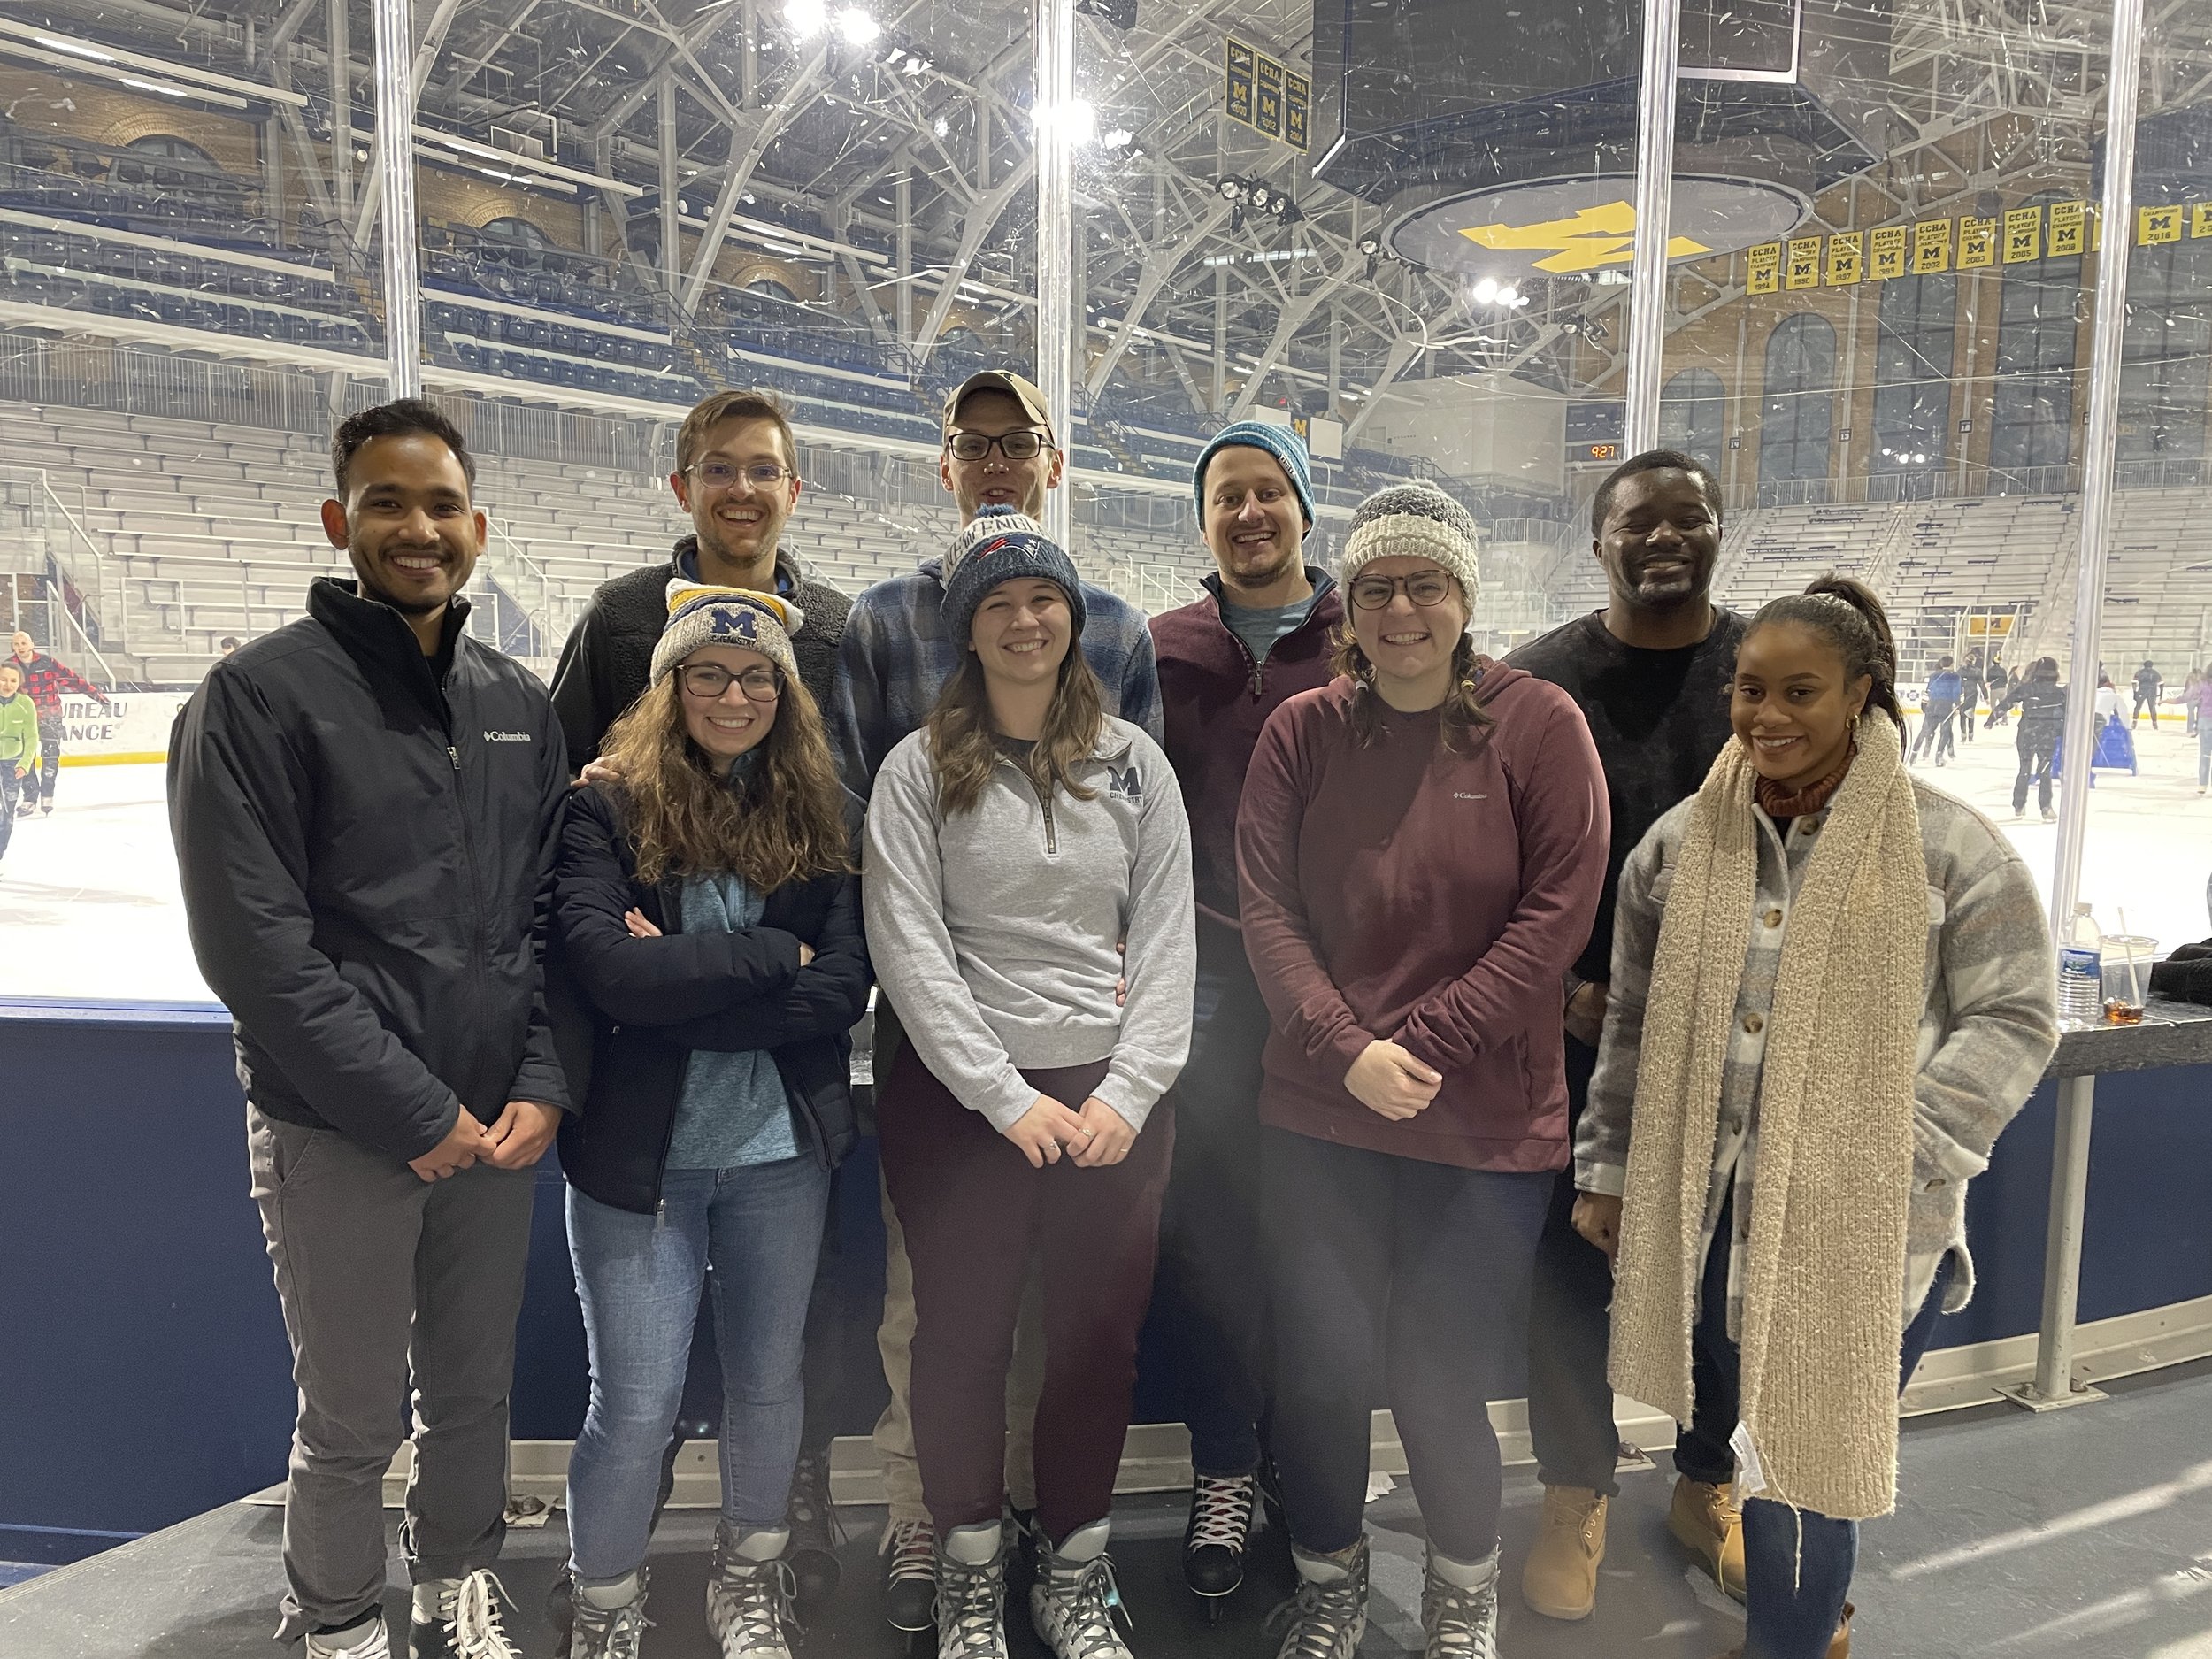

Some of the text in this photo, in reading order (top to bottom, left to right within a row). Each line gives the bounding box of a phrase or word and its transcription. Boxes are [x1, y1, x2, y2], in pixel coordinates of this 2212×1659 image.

[1260, 63, 1279, 81] CCHA
[1233, 80, 1248, 103] M
[1288, 77, 1307, 96] CCHA
[1262, 96, 1276, 117] M
[1290, 110, 1302, 130] M
[2008, 211, 2037, 222] CCHA
[2054, 205, 2081, 216] CCHA
[1919, 223, 1947, 234] CCHA
[1964, 219, 1991, 227] CCHA
[2149, 216, 2171, 230] M
[1832, 235, 1859, 246] CCHA
[1875, 230, 1901, 240] CCHA
[2057, 227, 2076, 242] M
[2147, 232, 2170, 241] 2016
[1792, 241, 1816, 250] CCHA
[1967, 241, 1986, 254] M
[2012, 234, 2032, 249] M
[1752, 247, 1777, 257] CCHA
[1878, 252, 1896, 265] M
[1923, 246, 1941, 259] M
[2010, 250, 2032, 259] 2005
[1794, 263, 1811, 275] M
[1836, 258, 1853, 272] M
[1755, 269, 1771, 281] M
[1294, 419, 1307, 437] M
[1592, 446, 1615, 458] 9:27
[946, 524, 976, 574] NEW
[711, 609, 757, 639] M
[489, 731, 531, 741] Columbia
[1108, 766, 1142, 795] M
[1110, 792, 1142, 803] CHESTRY
